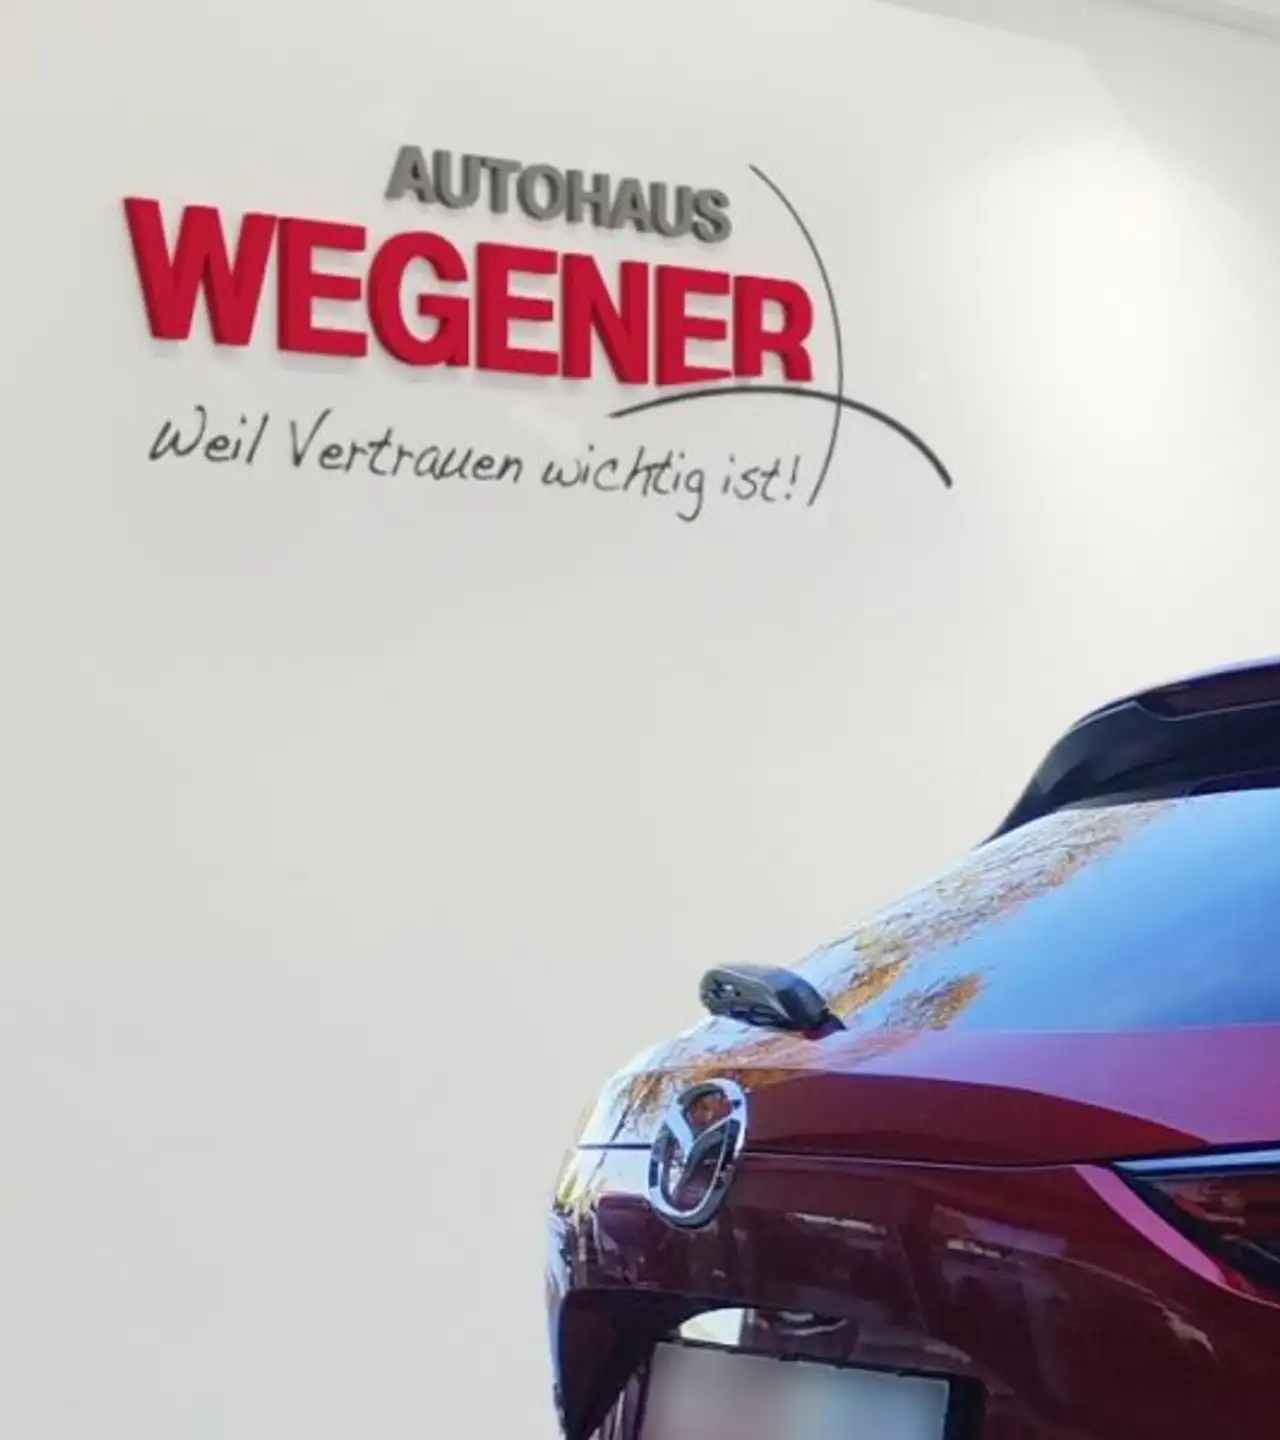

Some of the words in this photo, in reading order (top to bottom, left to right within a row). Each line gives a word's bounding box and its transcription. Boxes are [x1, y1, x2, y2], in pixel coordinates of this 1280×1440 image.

[384, 144, 732, 243] AUTOHAUS
[124, 196, 814, 386] WEGENER
[148, 404, 269, 464] Weil
[290, 408, 524, 484] Vertrauen
[540, 443, 705, 523] wichtig
[721, 454, 801, 502] ist!
